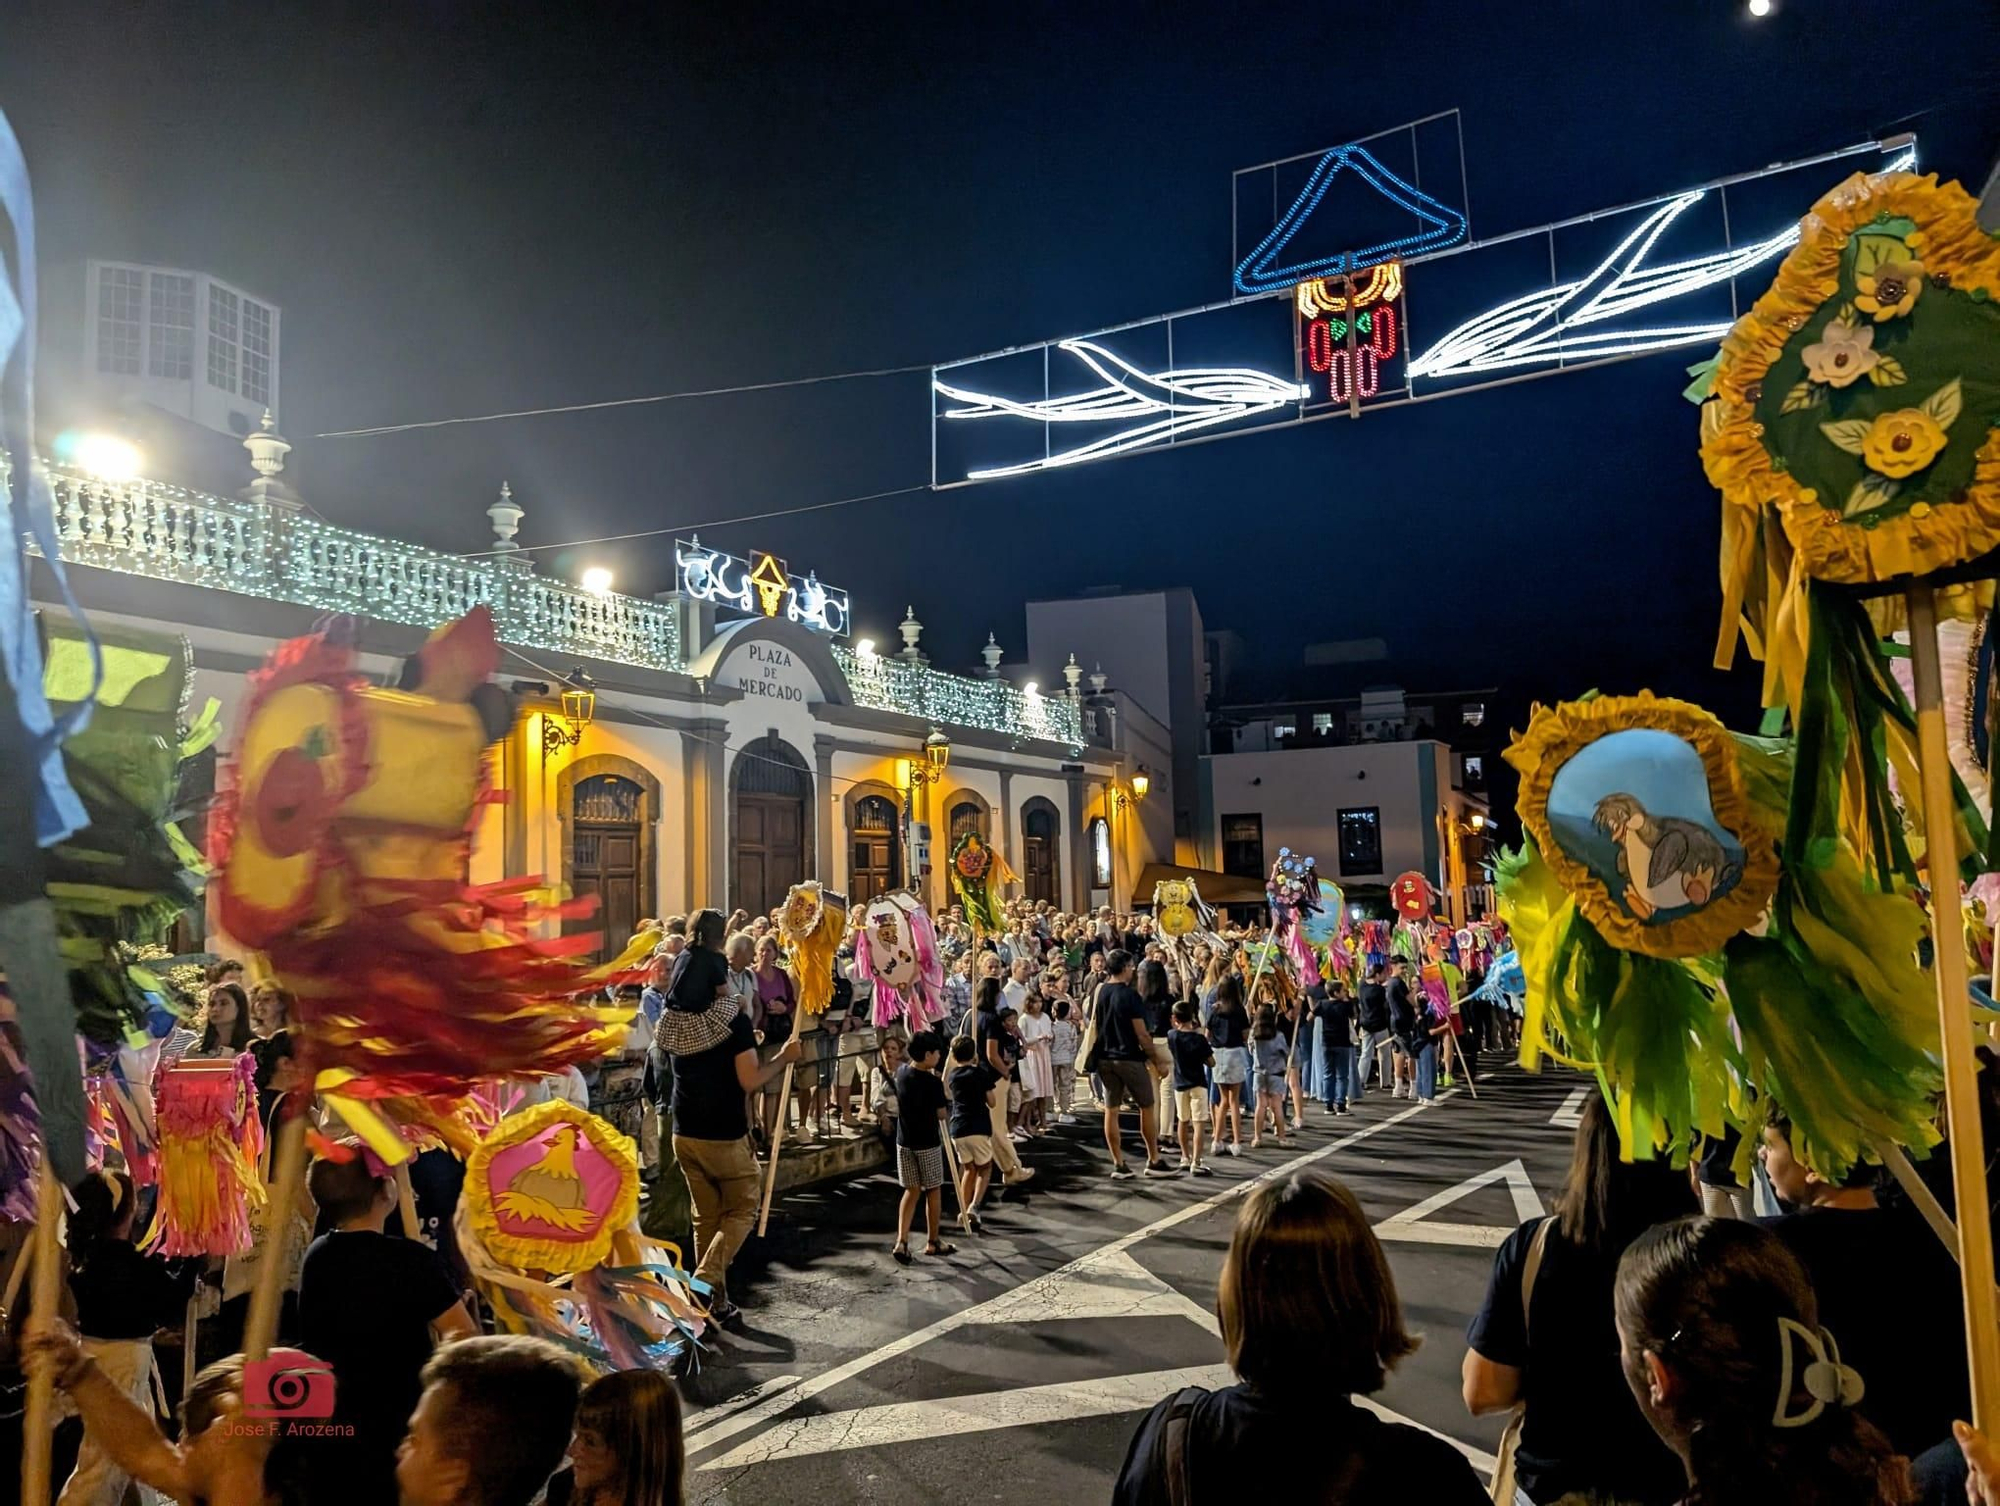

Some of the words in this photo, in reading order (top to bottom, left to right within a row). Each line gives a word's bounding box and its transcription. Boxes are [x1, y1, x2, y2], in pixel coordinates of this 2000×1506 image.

[749, 644, 791, 667] PLAZA
[764, 667, 777, 679] DE
[739, 678, 802, 701] MERCADO
